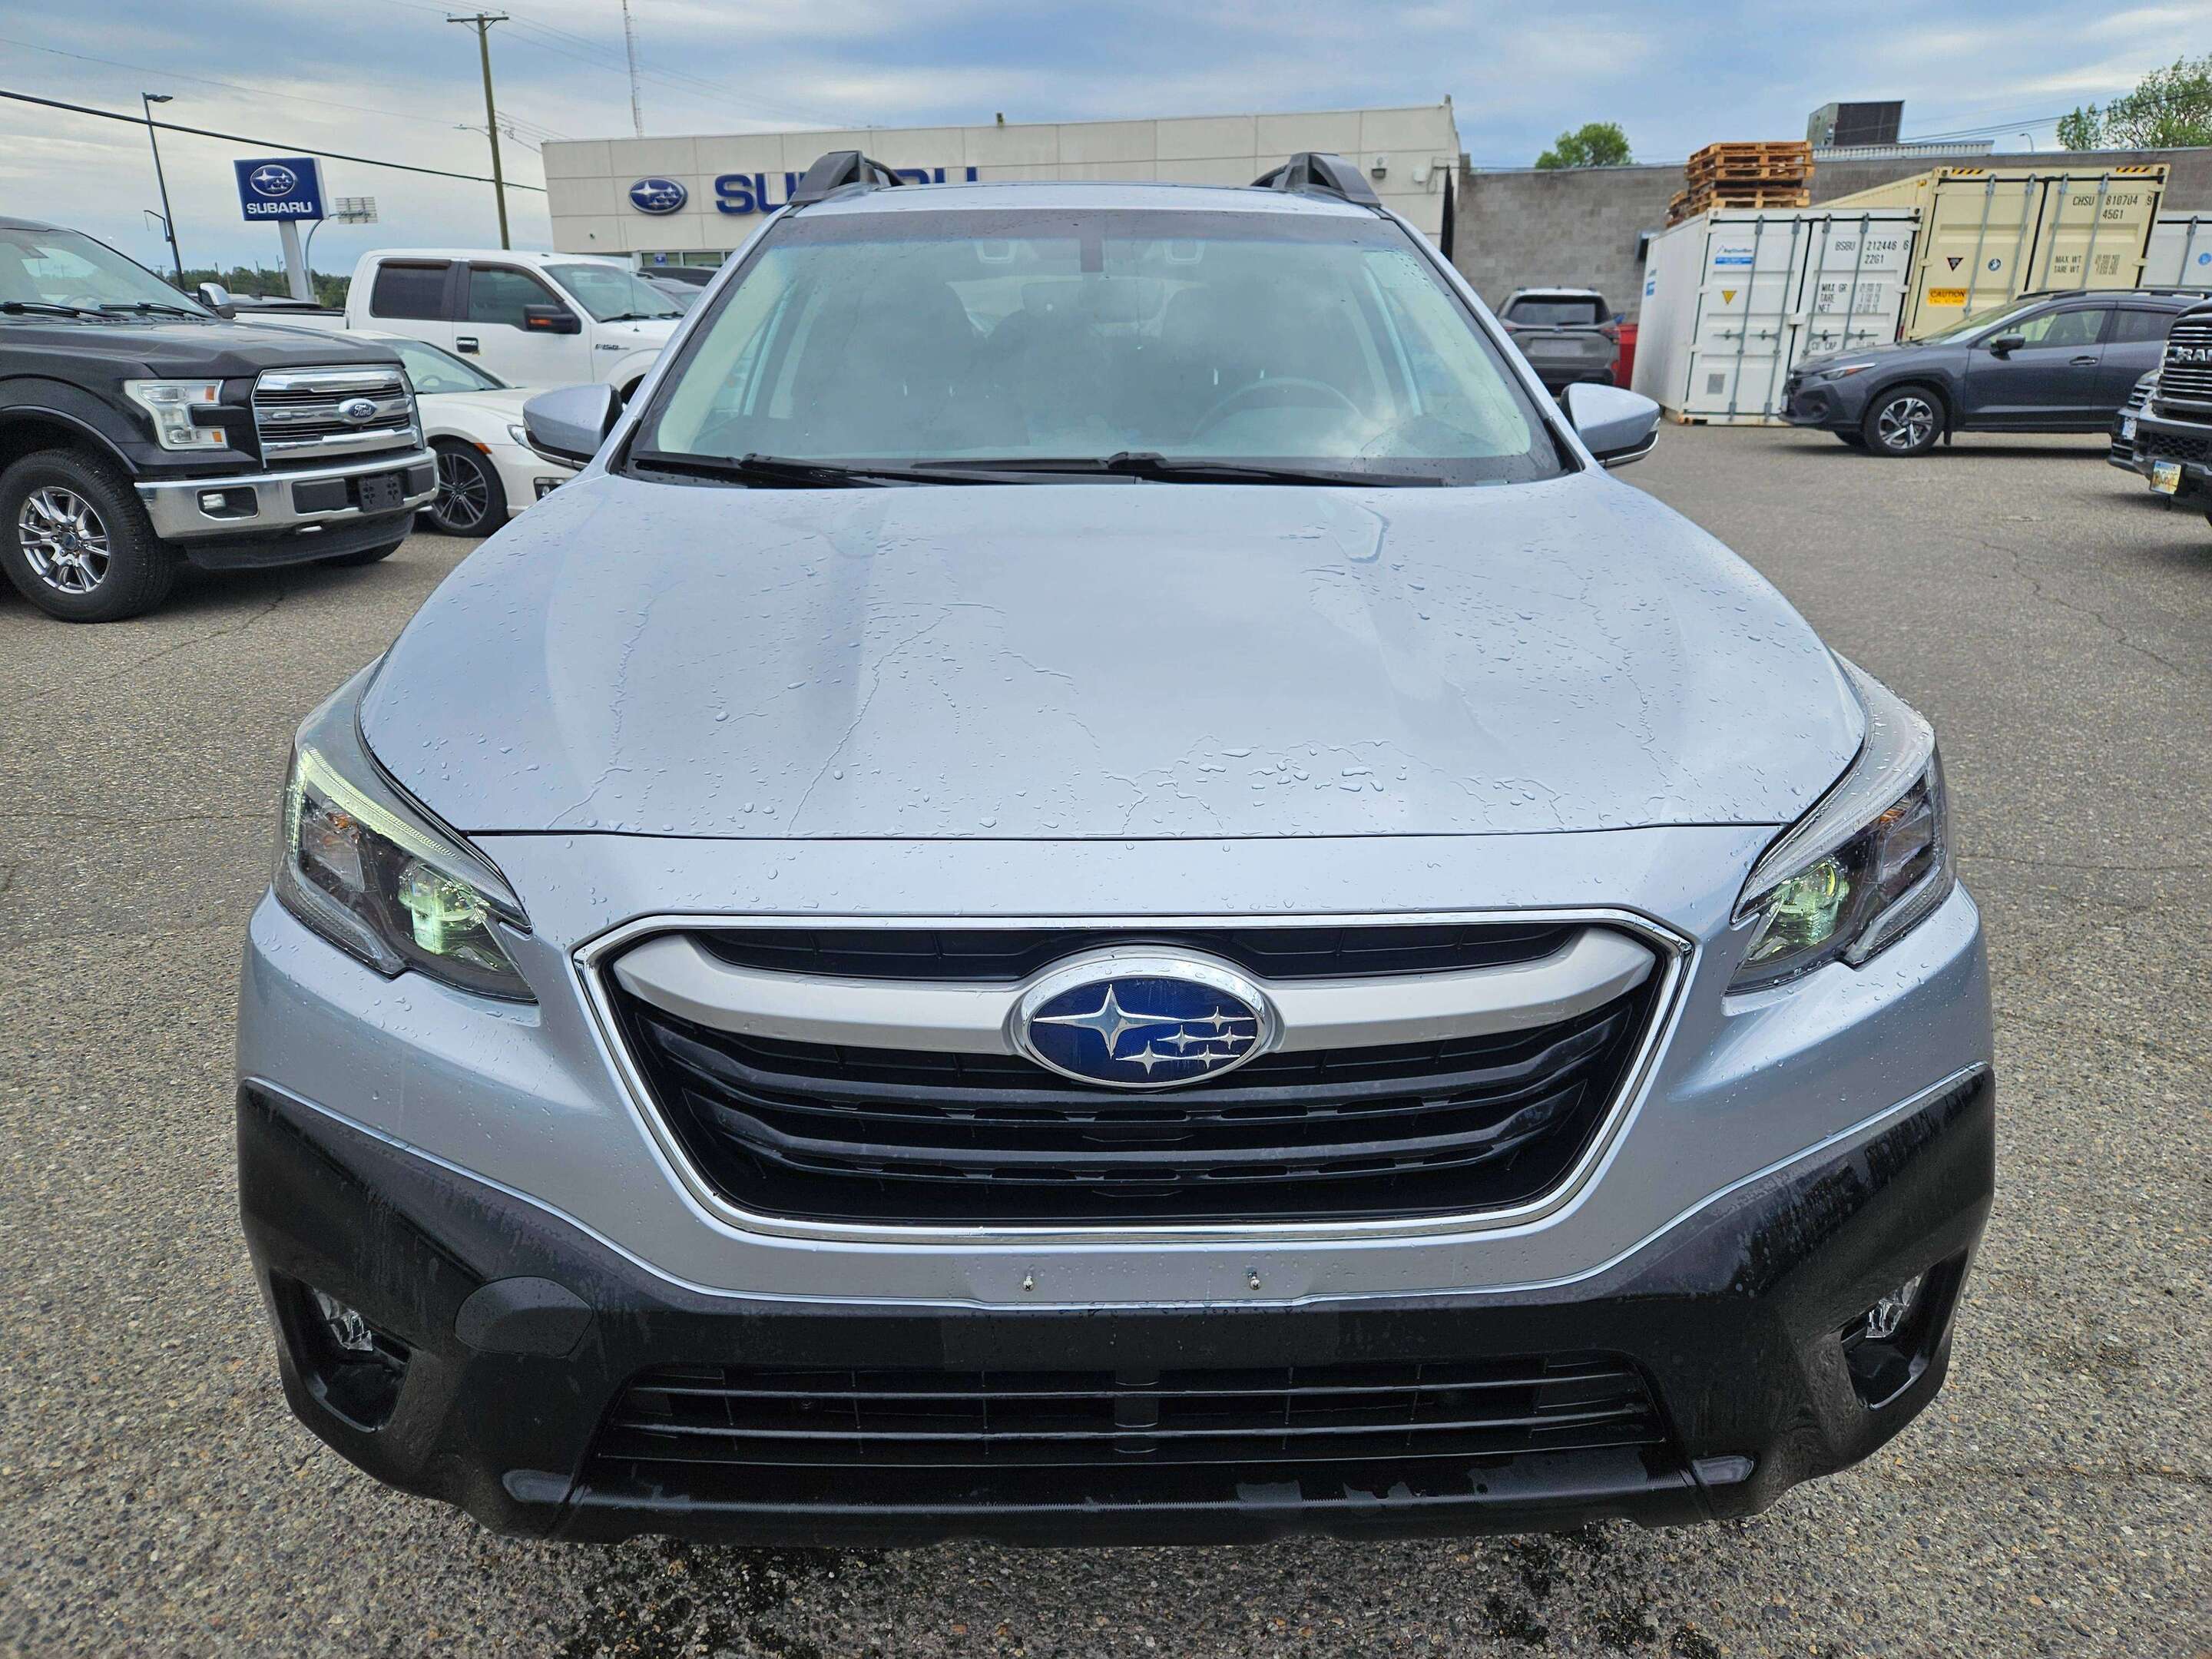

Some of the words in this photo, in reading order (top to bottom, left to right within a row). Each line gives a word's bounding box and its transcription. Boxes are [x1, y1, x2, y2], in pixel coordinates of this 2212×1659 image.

[2072, 196, 2094, 206] CHSU
[2105, 195, 2138, 206] 810704
[246, 202, 313, 214] SUBARU
[2102, 209, 2124, 220] 45G1
[1866, 240, 1898, 251] 212446
[1864, 254, 1884, 264] 22G1
[1930, 290, 1965, 298] CAUTION
[354, 404, 372, 416] Ford
